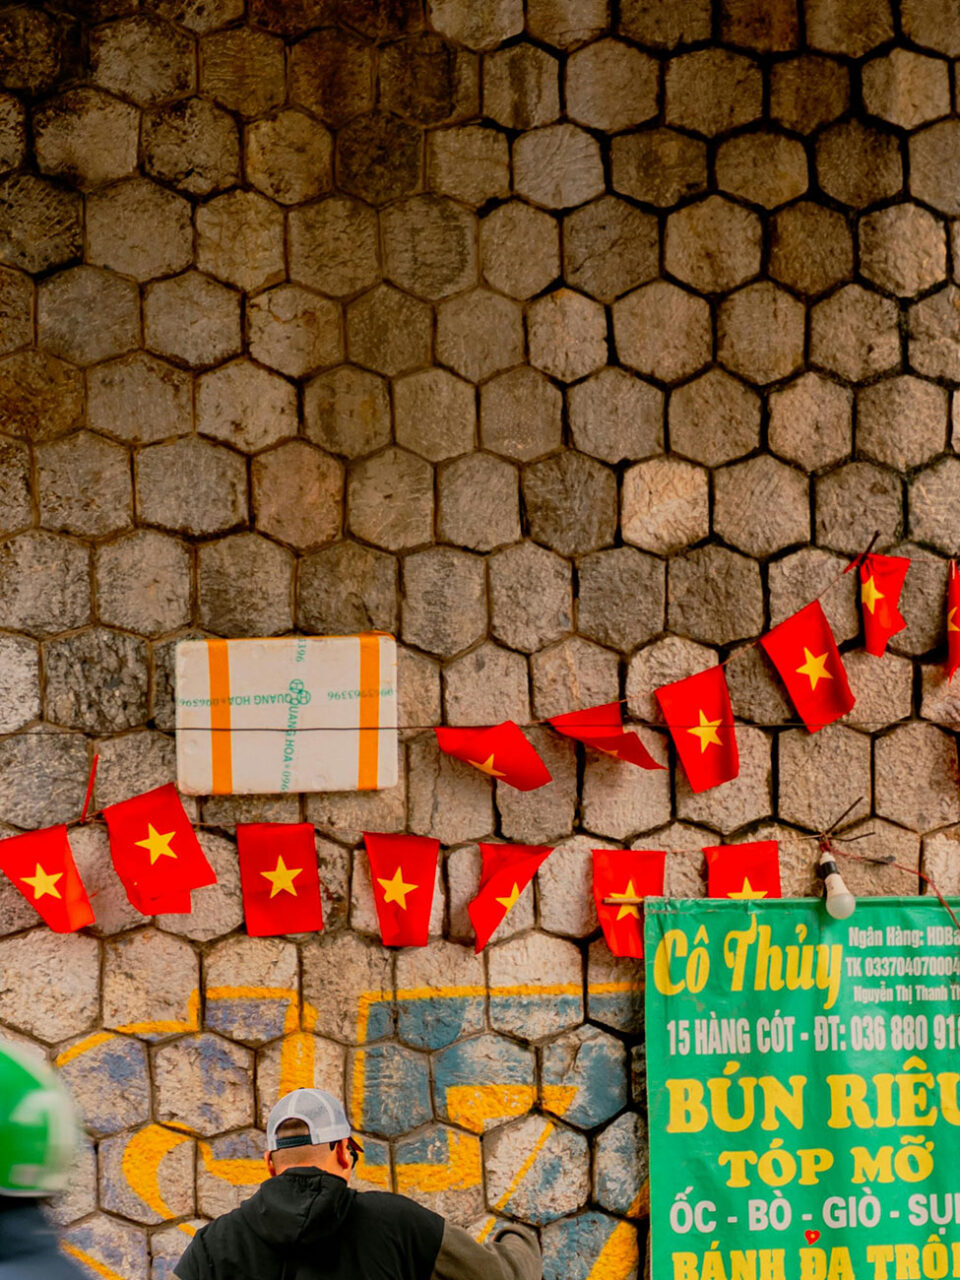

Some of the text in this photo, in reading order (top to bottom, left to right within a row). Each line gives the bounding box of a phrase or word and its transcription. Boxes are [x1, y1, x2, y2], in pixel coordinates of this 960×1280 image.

[228, 696, 251, 707] HOA
[283, 739, 295, 764] HOA
[848, 926, 883, 948] Ngân
[886, 925, 925, 948] Hàng:
[653, 914, 843, 1009] Cô Thủy
[845, 957, 862, 977] TK
[853, 981, 893, 1004] Nguyễn
[895, 984, 913, 1005] Thị
[915, 985, 948, 1001] Thanh
[666, 1019, 690, 1055] 15
[695, 1011, 750, 1055] HÀNG
[757, 1009, 796, 1053] CÓT
[814, 1015, 847, 1052] ĐT:
[851, 1015, 886, 1051] 036
[890, 1014, 928, 1051] 880
[665, 1060, 807, 1134] BÚN
[718, 1135, 934, 1188] TÓP MỠ
[669, 1186, 717, 1234] ỐC
[748, 1190, 792, 1232] BÒ
[822, 1187, 881, 1229] GIÒ
